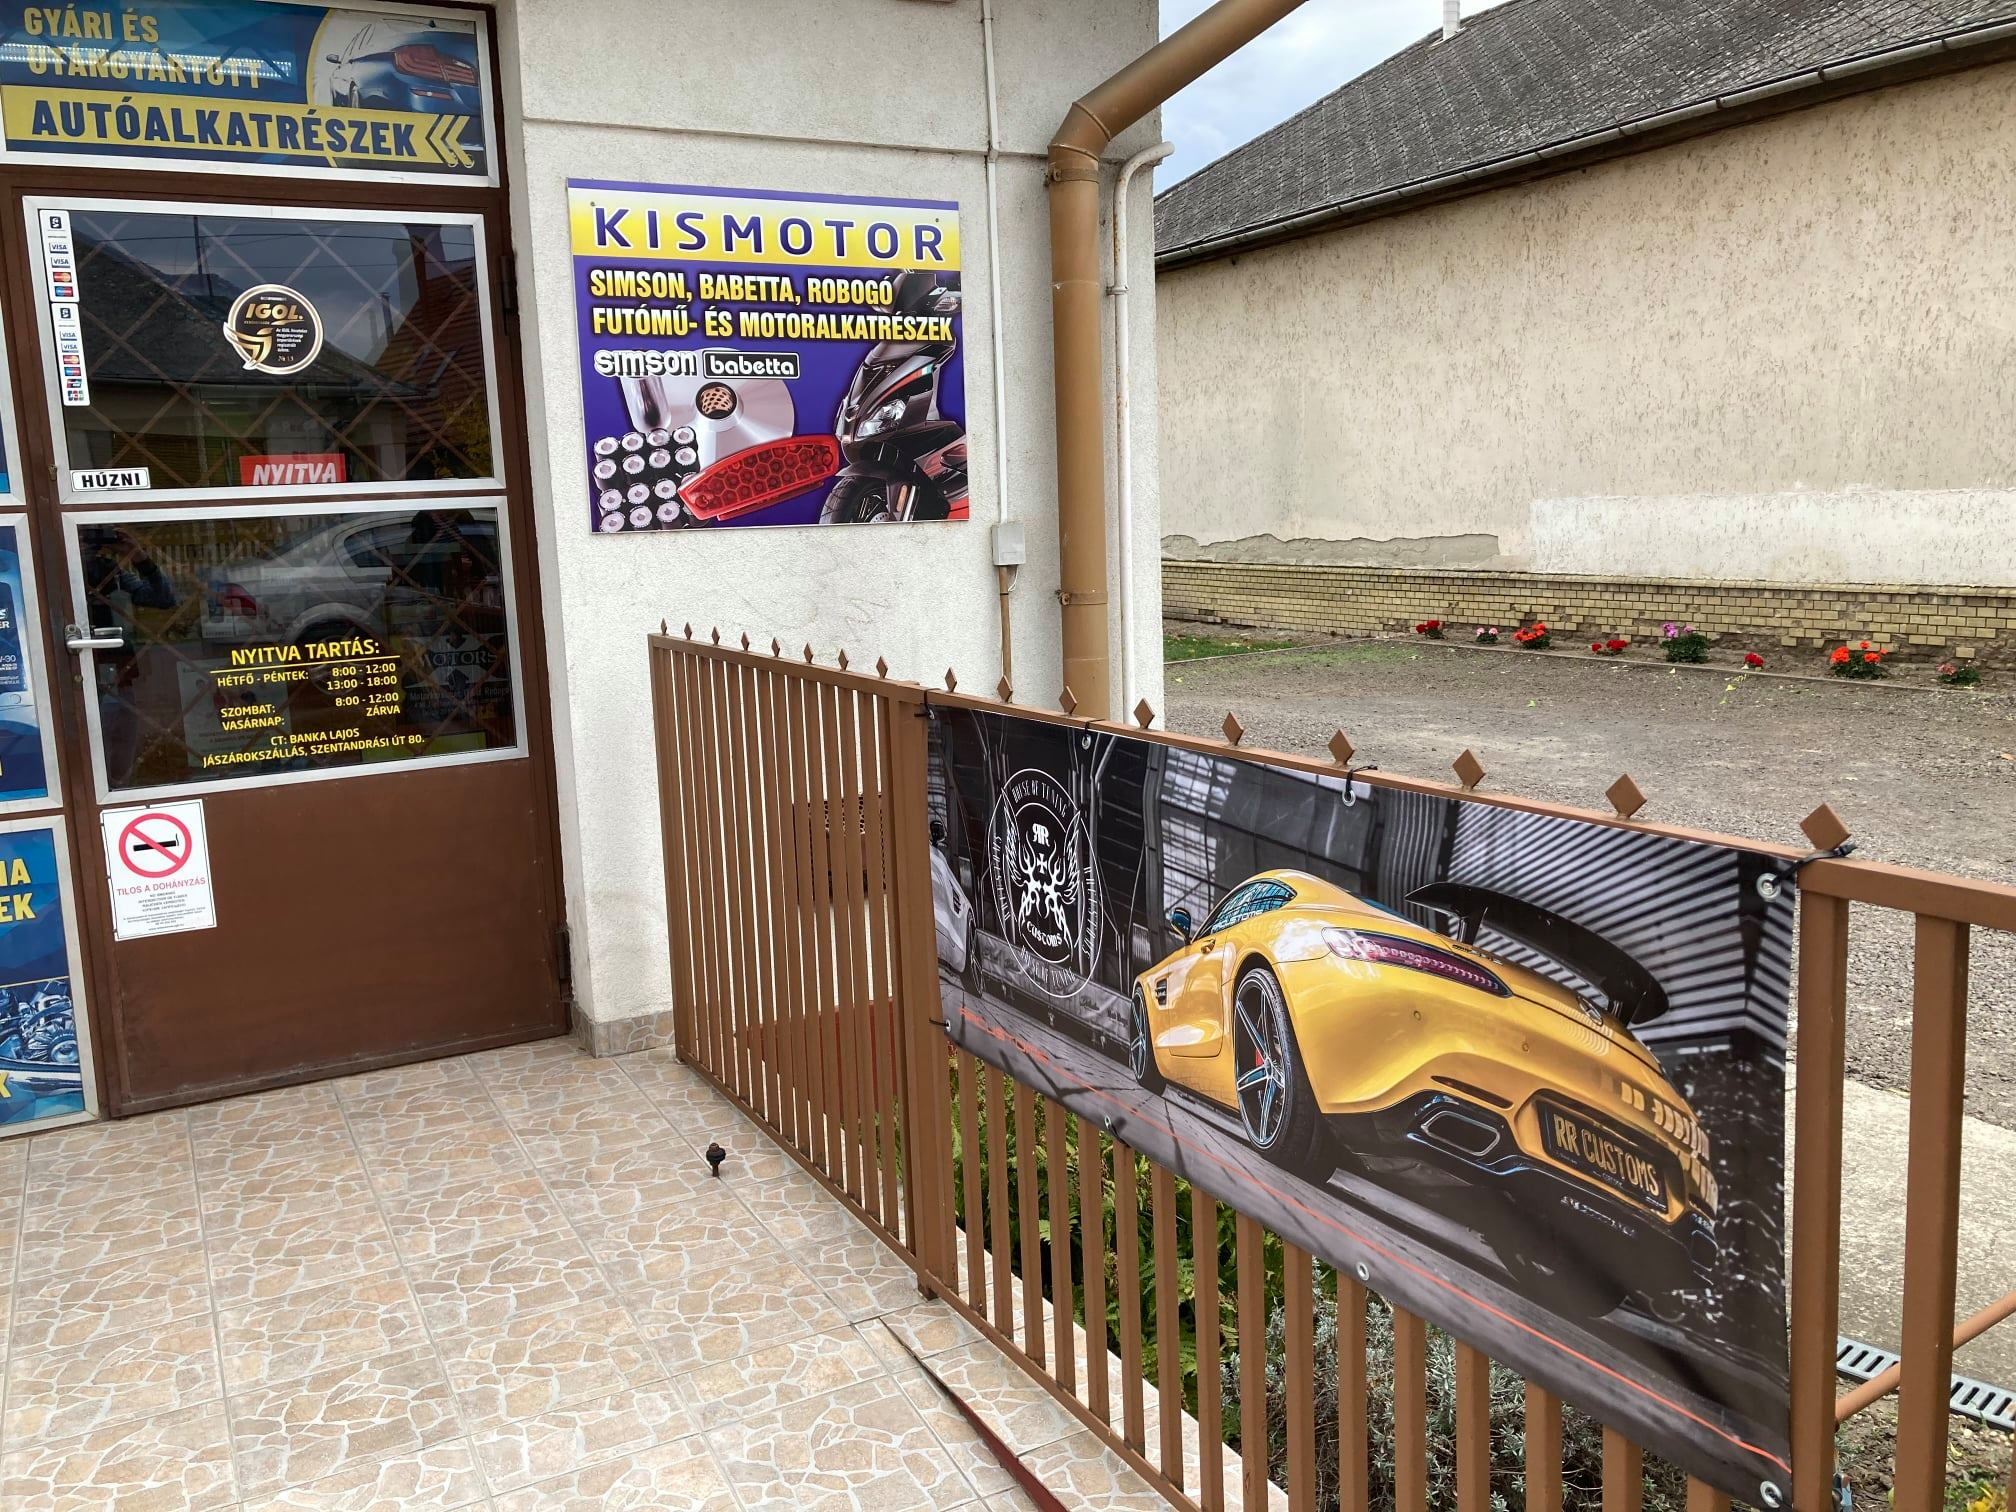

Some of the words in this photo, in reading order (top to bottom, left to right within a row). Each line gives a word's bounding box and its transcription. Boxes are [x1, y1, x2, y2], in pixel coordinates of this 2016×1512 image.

[24, 7, 112, 41] GYÁRI
[122, 7, 159, 44] ÉS
[27, 42, 262, 88] UTÁNGYÁRTOTT
[31, 96, 418, 157] AUTÓALKATRÉSZEK
[593, 206, 944, 262] KISMOTOR
[589, 269, 693, 302] SIMSON,
[700, 273, 801, 306] BABETTA,
[807, 276, 894, 306] ROBOGÓ
[592, 306, 698, 337] FUTÓMŰ-
[705, 307, 733, 338] ÉS
[740, 312, 954, 342] MOTORALKATRÉSZEK
[709, 353, 795, 377] babetta
[82, 471, 141, 488] HÚZNI
[252, 462, 337, 486] NYITVA
[231, 645, 301, 666] NYITVA
[305, 637, 380, 659] TARTÁS:
[217, 671, 254, 688] HÉTFŐ
[264, 669, 309, 684] PÉNTEK:
[332, 666, 357, 677] 8:00
[366, 662, 396, 674] 12:00
[326, 678, 358, 690] 13:00
[367, 675, 397, 687] 18:00
[220, 704, 276, 718] SZOMBAT:
[335, 695, 360, 707] 8:00
[369, 692, 399, 704] 12:00
[366, 703, 400, 717] ZÁRVA
[222, 716, 285, 731] VASÁRNAP:
[271, 735, 287, 746] CT:
[290, 732, 327, 744] BANKA
[329, 727, 360, 741] LAJOS
[203, 745, 308, 768] JÁSZÁROKSZÁLLÁS,
[310, 736, 390, 756] SZENTANDRÁSI
[392, 734, 406, 746] ÚT
[408, 734, 425, 744] 80.
[116, 886, 143, 897] TILOS
[144, 884, 151, 892] A
[153, 876, 206, 891] DOHÁNYZÁS
[1553, 1113, 1581, 1157] RR
[1581, 1128, 1660, 1197] CUSTOMS
